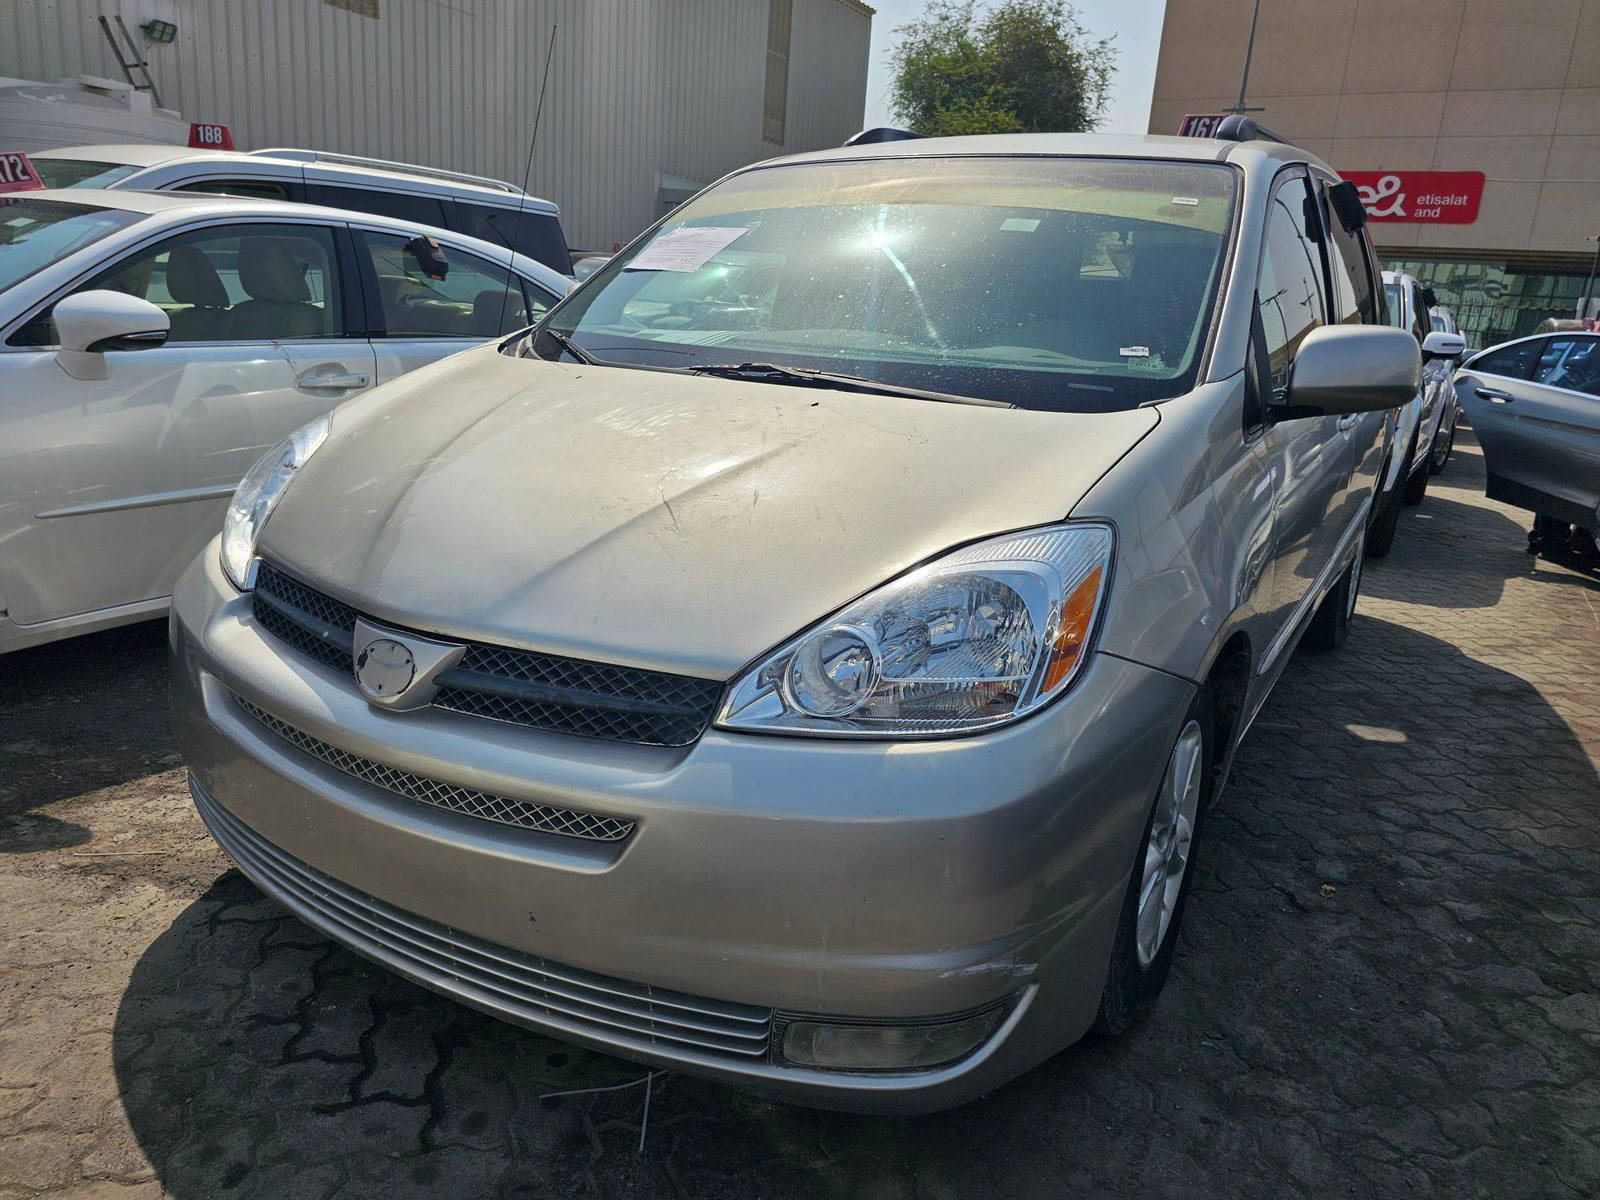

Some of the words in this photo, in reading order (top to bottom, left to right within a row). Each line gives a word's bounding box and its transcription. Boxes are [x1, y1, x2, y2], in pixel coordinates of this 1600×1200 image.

[197, 126, 223, 144] 188
[1188, 117, 1220, 138] 161
[0, 156, 30, 182] 72
[1417, 194, 1468, 206] etisalat
[1414, 207, 1441, 218] and
